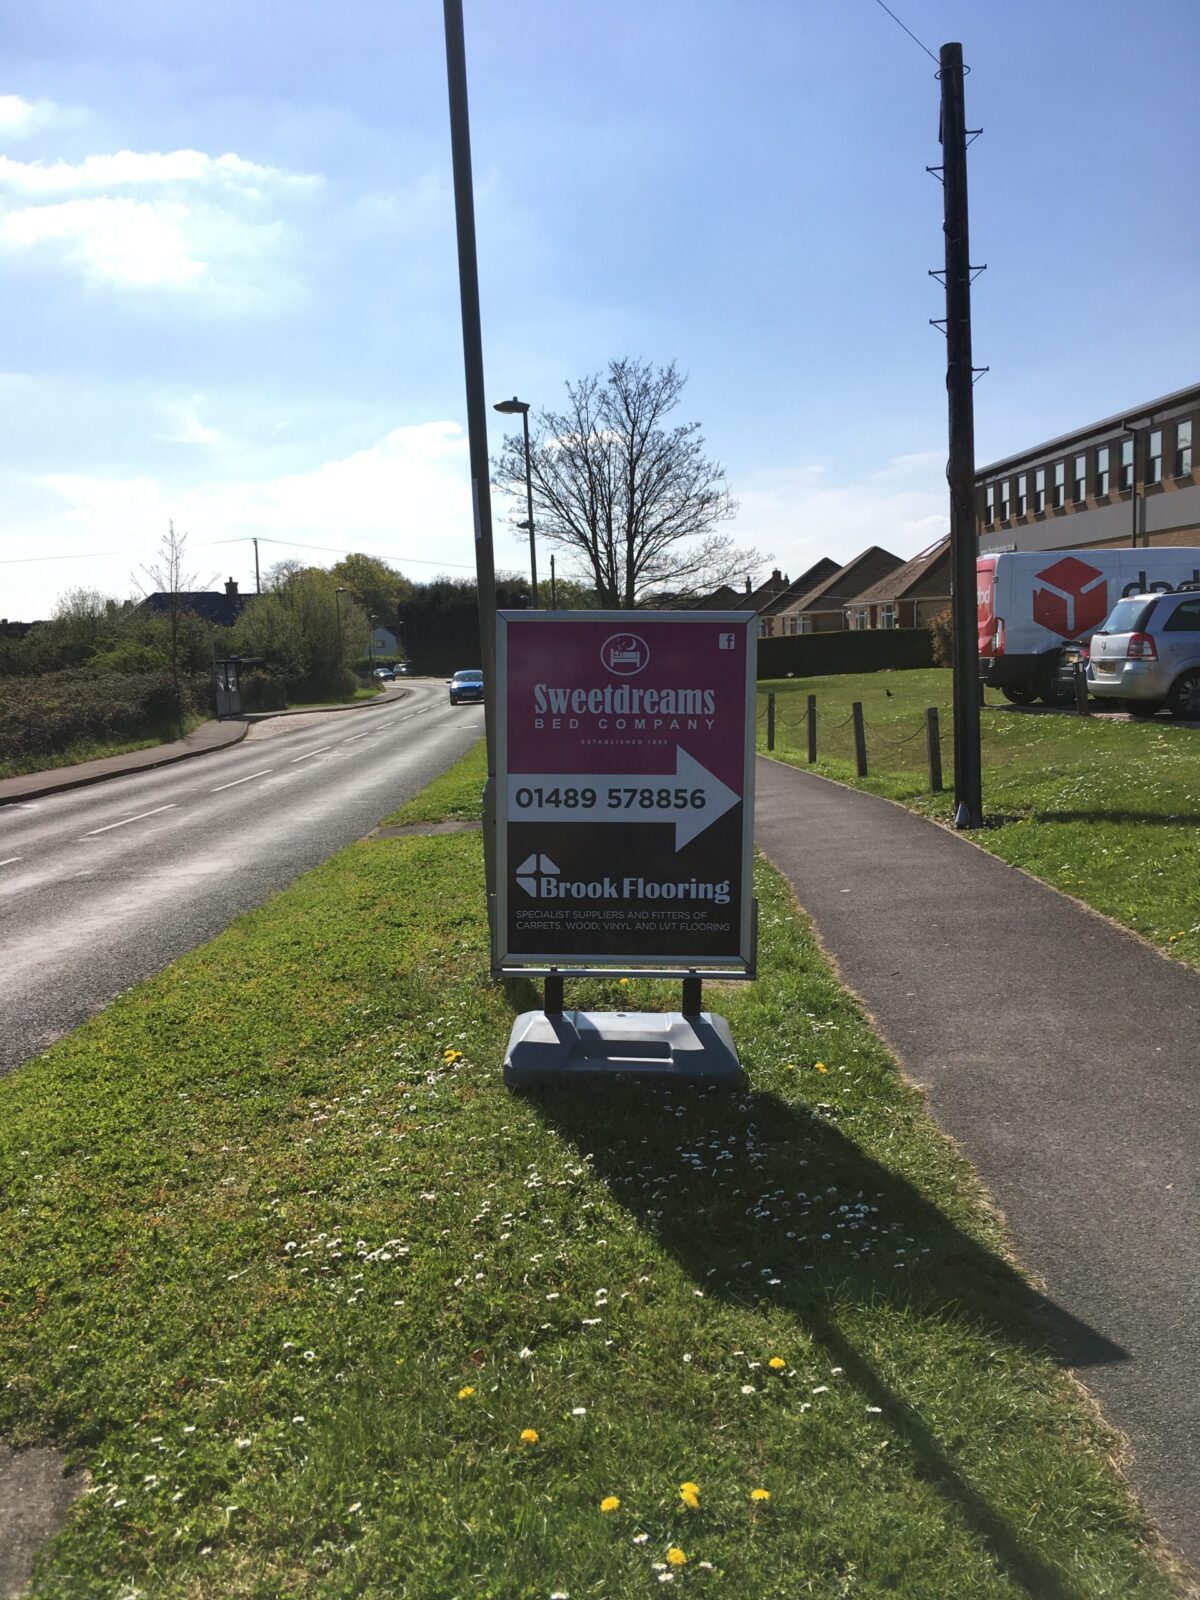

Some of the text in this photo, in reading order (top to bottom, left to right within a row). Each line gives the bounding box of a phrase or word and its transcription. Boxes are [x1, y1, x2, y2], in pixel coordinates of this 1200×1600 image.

[534, 683, 716, 715] Sweetdreams
[534, 718, 716, 730] BED COMPANY
[515, 787, 707, 810] 01489 578856
[540, 877, 731, 904] Brook Flooring
[516, 910, 708, 920] SPECIALIST SUPPLIERS AND FITTERS OF
[516, 921, 731, 932] CARPETS, WOOD, VINYL AND LVT FLOORING
